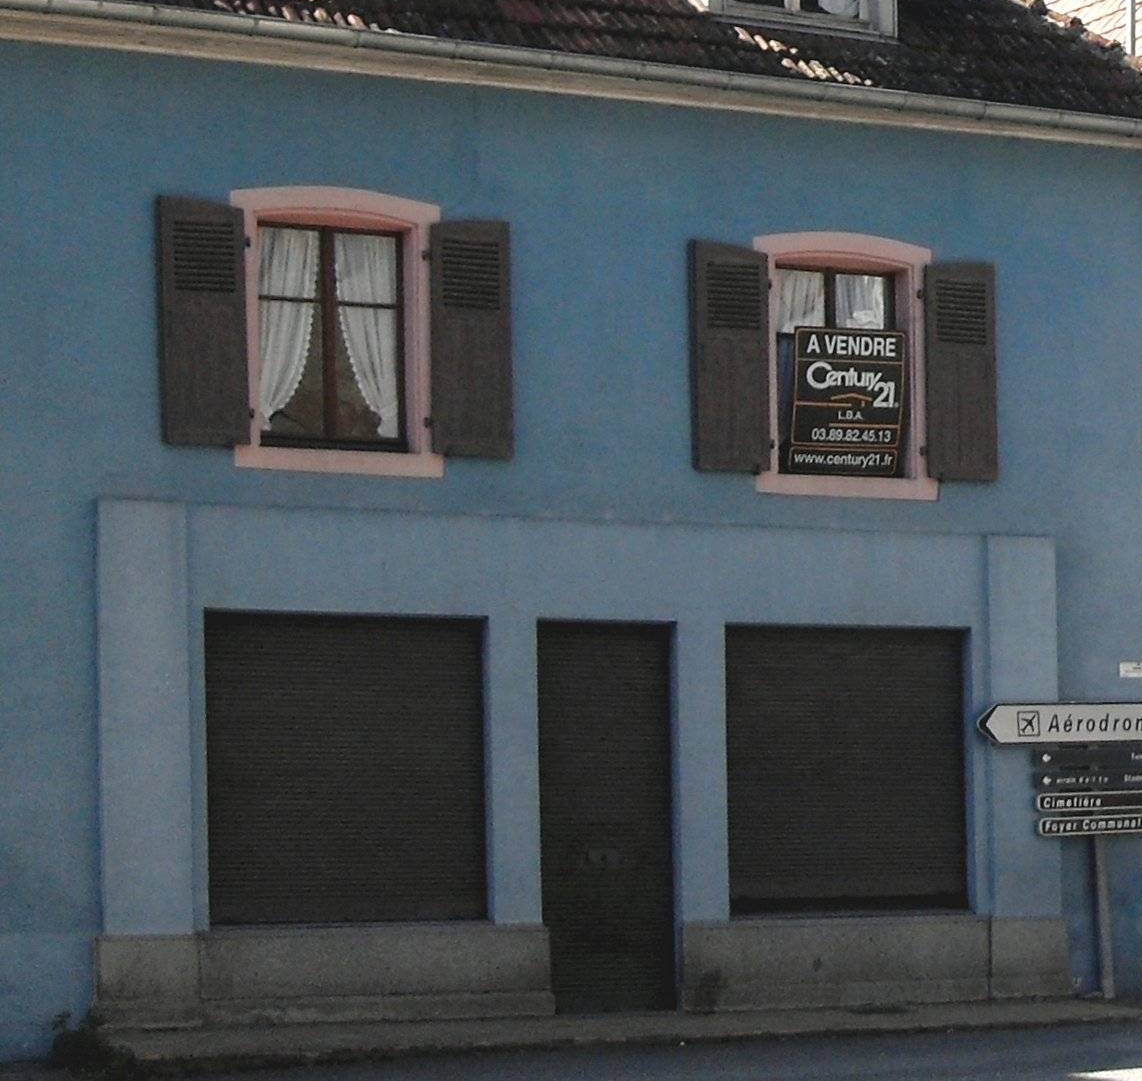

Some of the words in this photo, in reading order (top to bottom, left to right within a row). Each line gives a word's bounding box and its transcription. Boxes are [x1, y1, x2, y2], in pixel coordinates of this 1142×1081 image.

[806, 334, 821, 354] A
[824, 334, 897, 357] VENDRE
[806, 361, 882, 391] Century
[872, 381, 896, 408] 21
[793, 453, 893, 468] www.century21.fr
[1043, 797, 1102, 808] Cimetière
[1082, 818, 1142, 830] Communal
